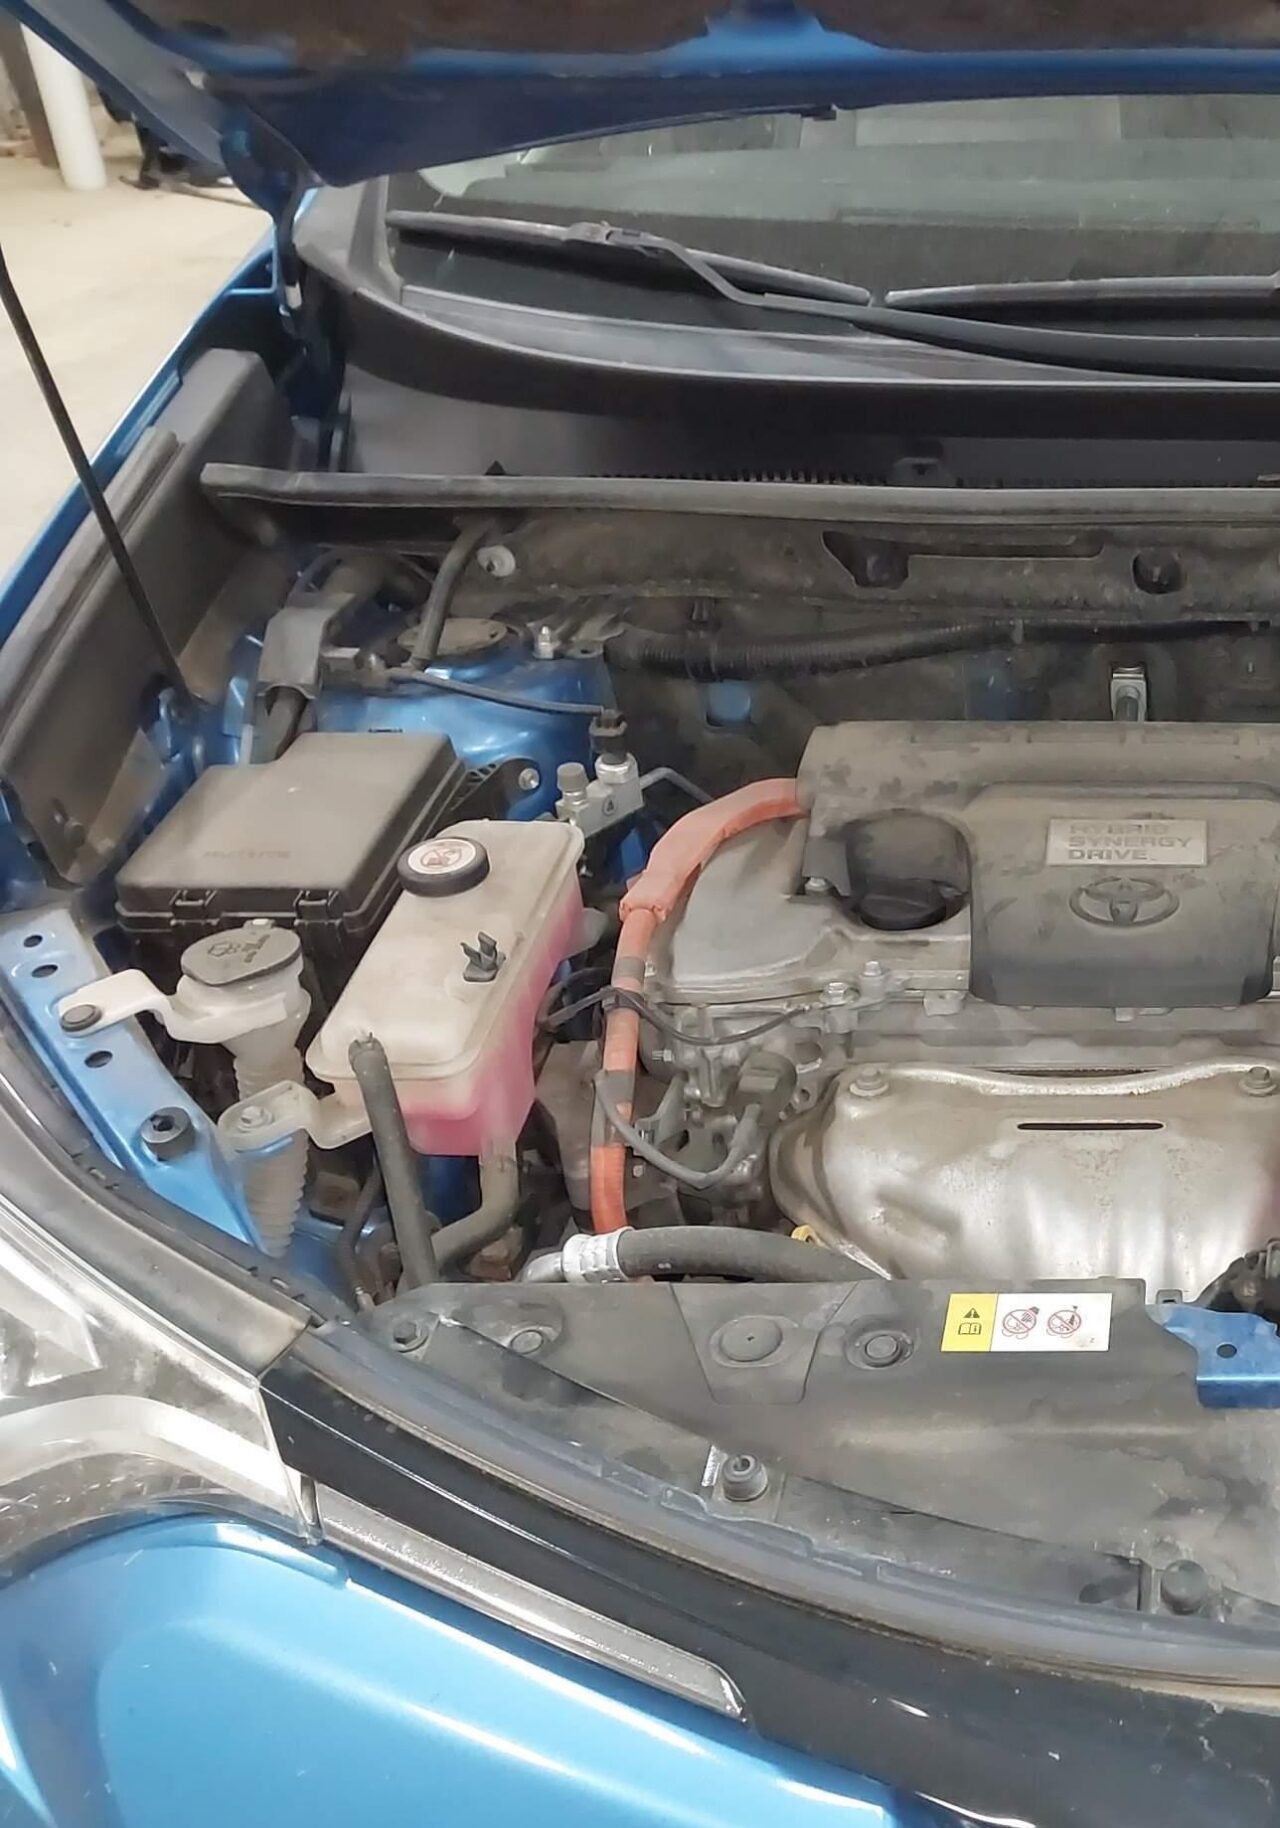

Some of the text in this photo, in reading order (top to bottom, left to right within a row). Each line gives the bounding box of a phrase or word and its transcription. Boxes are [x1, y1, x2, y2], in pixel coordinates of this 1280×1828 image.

[1069, 823, 1169, 835] HYBRID
[1068, 835, 1193, 848] SYNERGY
[1068, 849, 1148, 860] DRIVE
